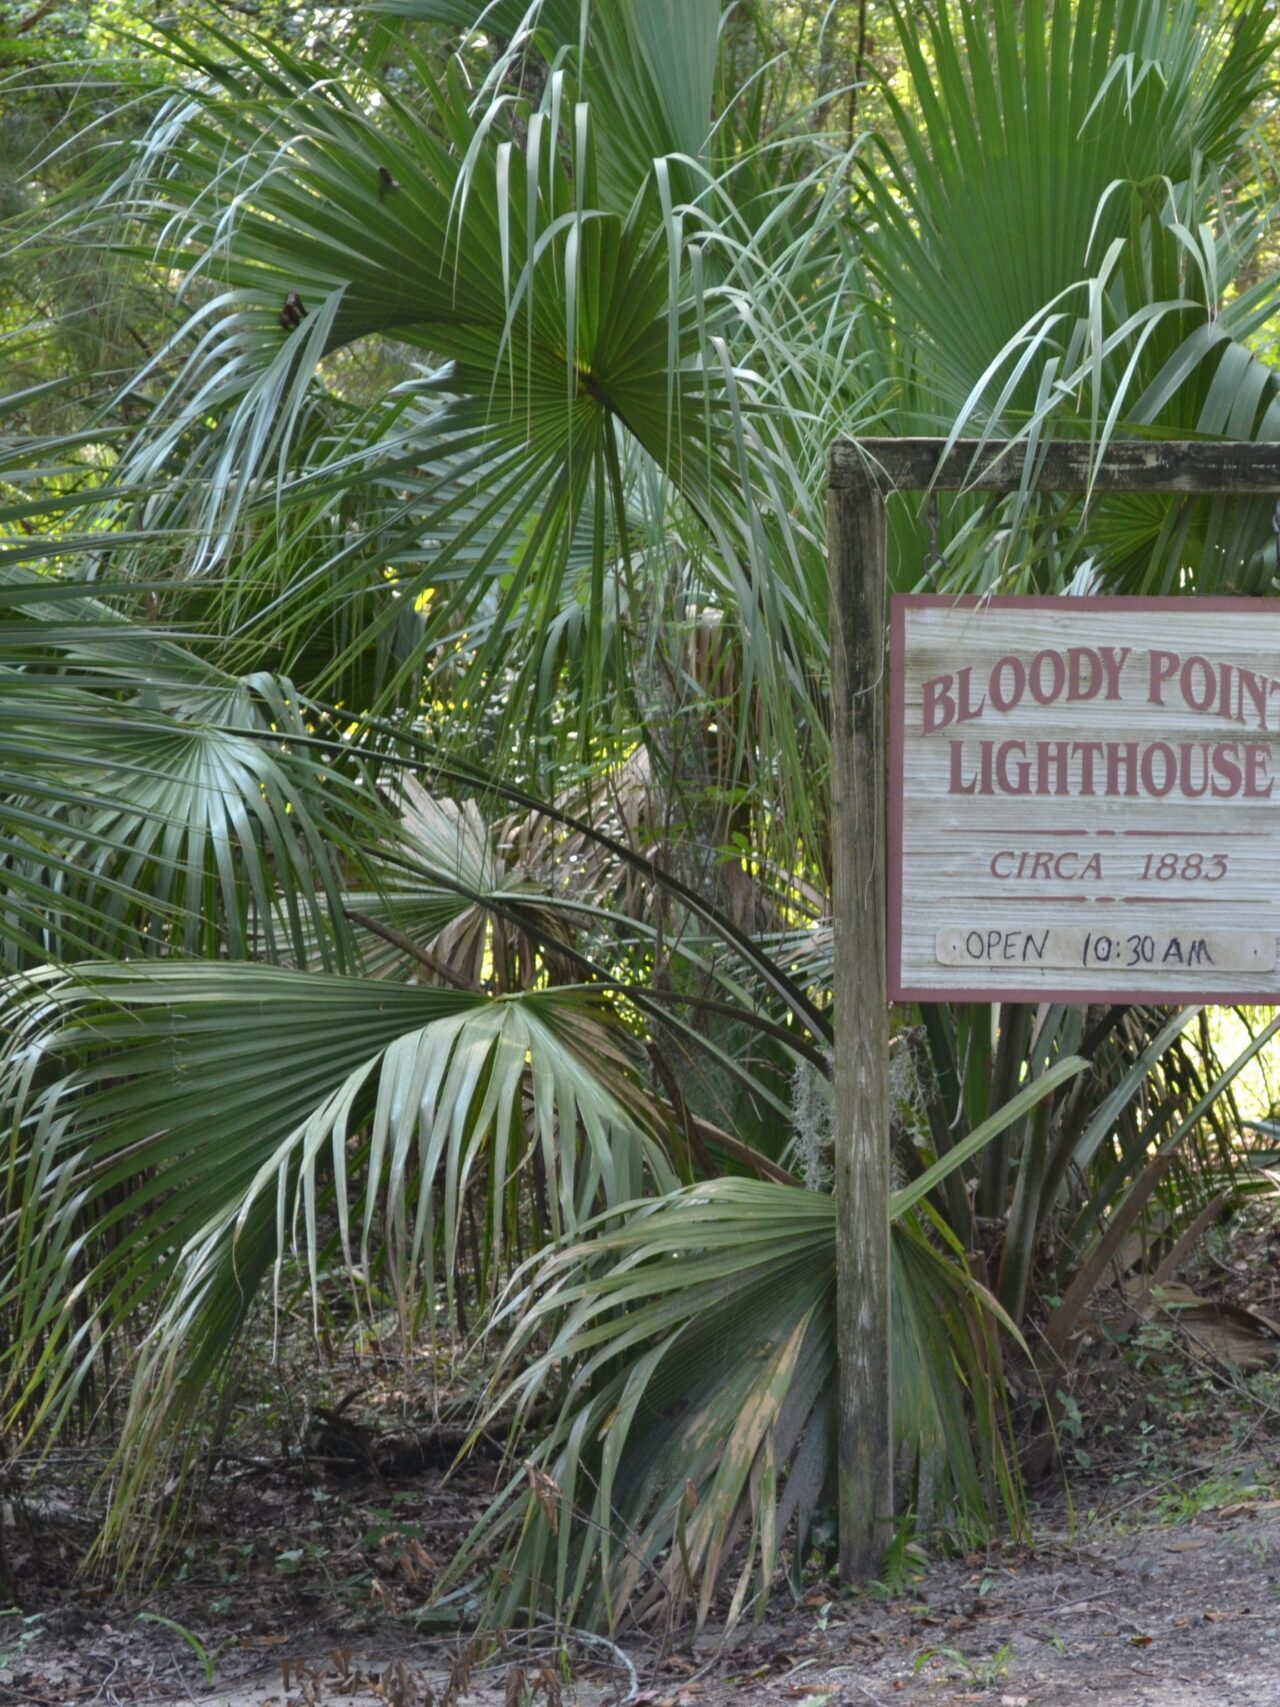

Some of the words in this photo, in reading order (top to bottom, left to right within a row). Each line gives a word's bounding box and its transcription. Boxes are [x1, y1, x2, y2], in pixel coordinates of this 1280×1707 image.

[921, 647, 1132, 735] BLOODY
[948, 740, 1275, 798] LIGHTHOUSE
[990, 851, 1103, 880] CIRCA
[1136, 853, 1229, 881] 1883
[965, 930, 1050, 960] OPEN
